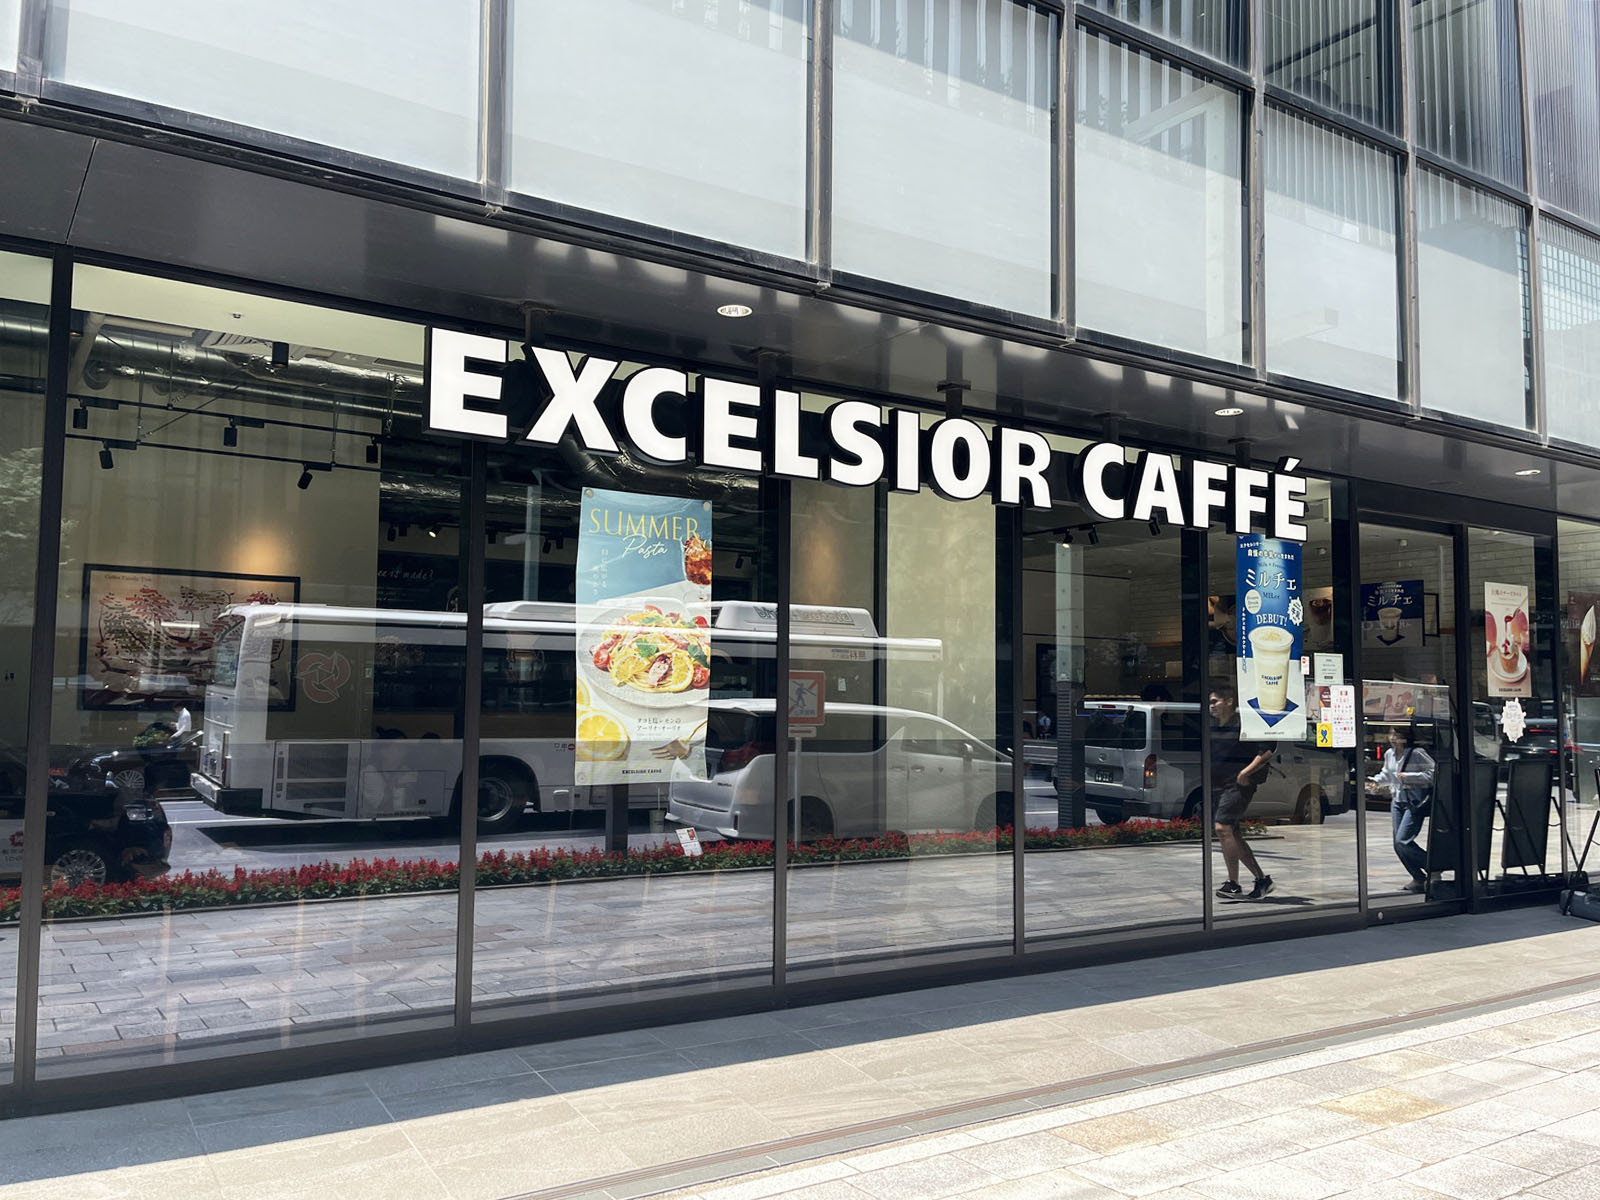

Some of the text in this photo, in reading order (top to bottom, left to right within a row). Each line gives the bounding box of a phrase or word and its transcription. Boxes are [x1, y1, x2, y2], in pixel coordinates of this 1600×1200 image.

[428, 326, 1308, 542] EXCELSIOR CAFFÉ
[588, 507, 699, 541] SUMMER
[622, 533, 668, 559] Pasta
[1245, 568, 1297, 591] ミルチェ
[1367, 594, 1413, 607] ミルチェ
[1256, 613, 1288, 626] DEBUT!
